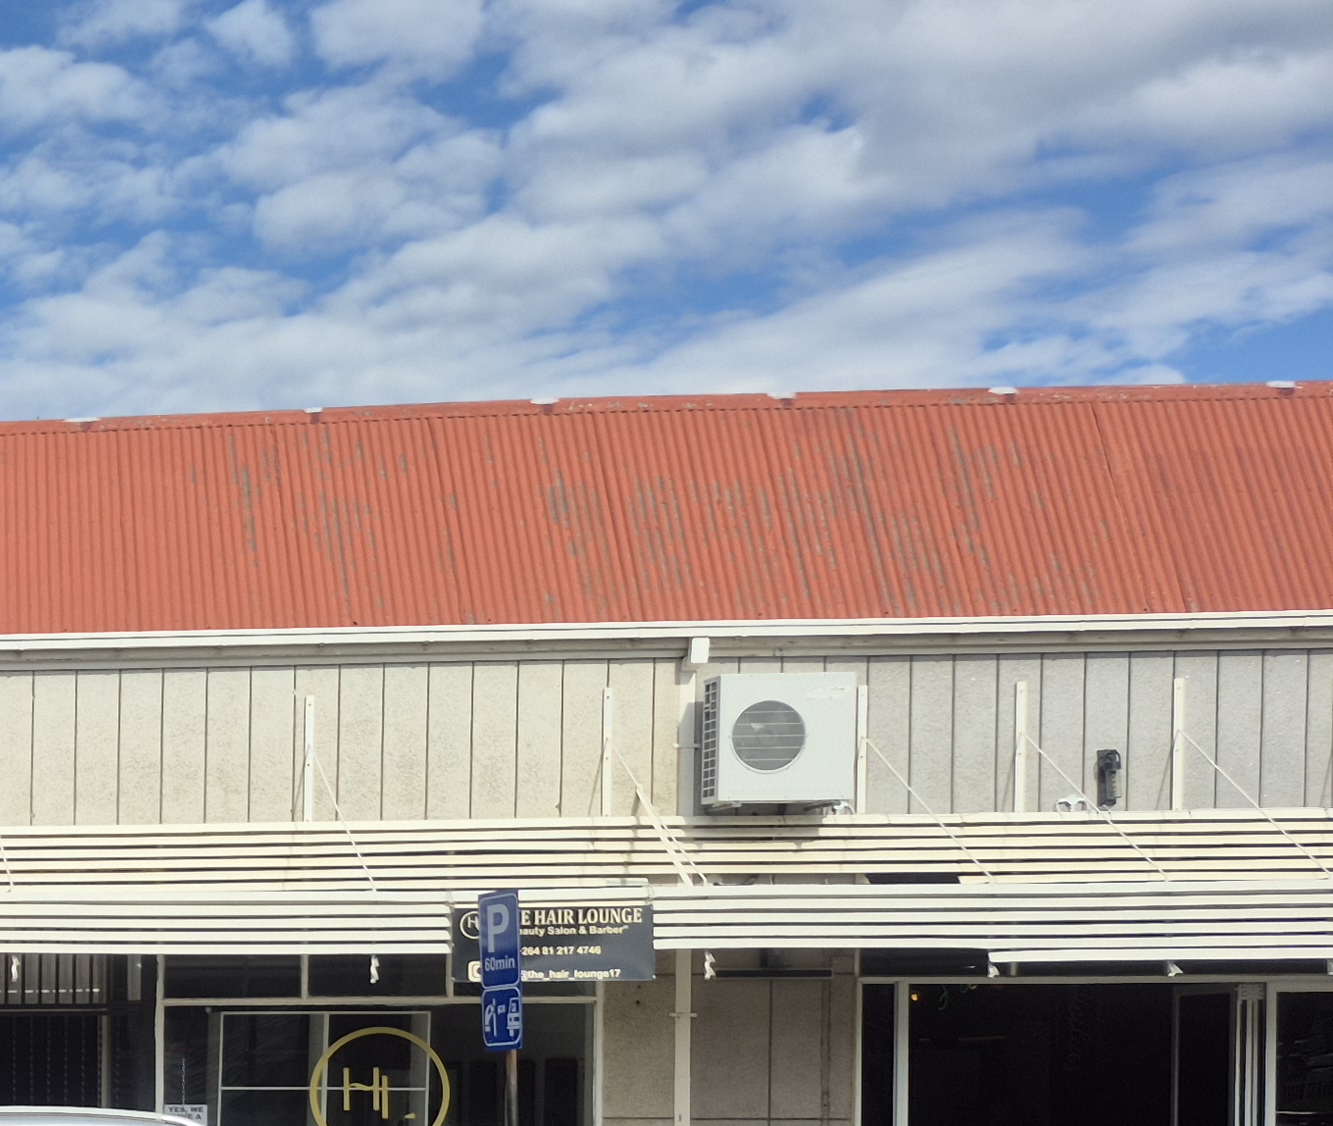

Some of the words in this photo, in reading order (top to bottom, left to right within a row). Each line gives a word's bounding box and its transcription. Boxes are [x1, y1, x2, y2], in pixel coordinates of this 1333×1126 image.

[534, 909, 575, 925] HAIR
[578, 908, 643, 924] LOUNGE
[487, 904, 510, 953] P
[547, 926, 576, 936] Salon
[579, 926, 587, 934] &
[520, 946, 540, 956] 264
[542, 946, 554, 955] 81
[557, 946, 574, 955] 217
[577, 946, 601, 955] 4746
[484, 955, 516, 971] 60min
